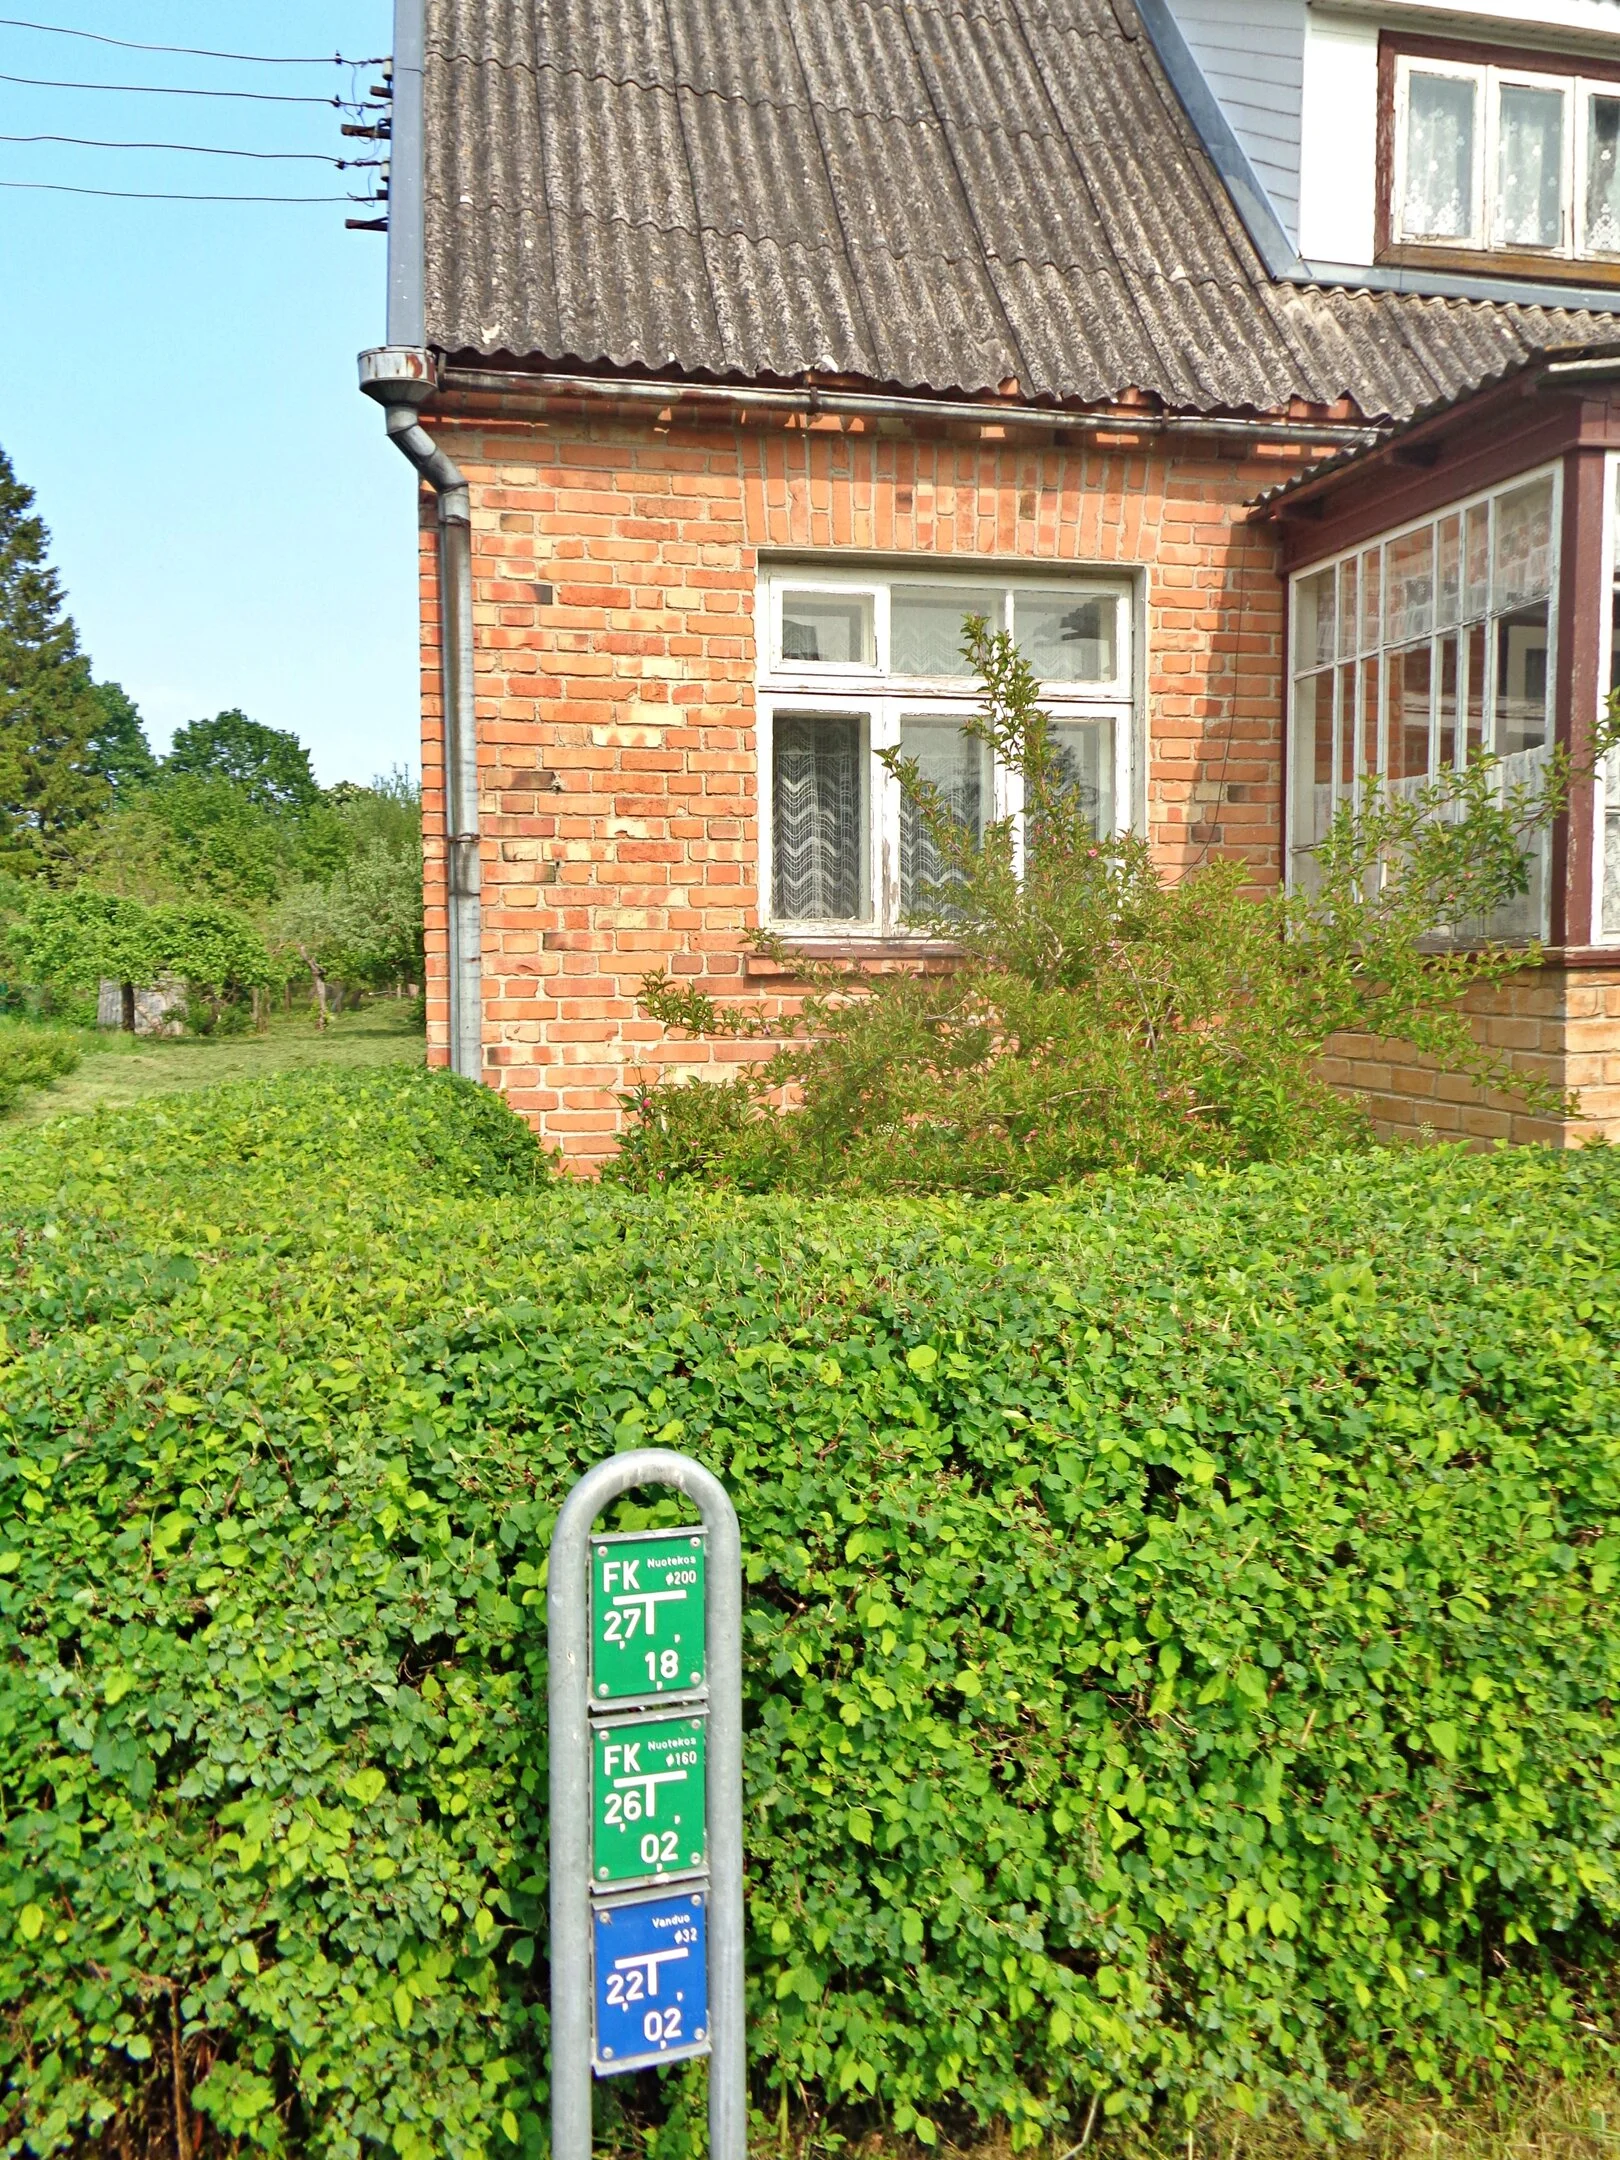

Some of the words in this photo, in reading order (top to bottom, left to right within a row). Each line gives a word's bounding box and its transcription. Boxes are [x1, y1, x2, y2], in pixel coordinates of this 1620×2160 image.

[647, 1555, 696, 1569] Nuotekos
[603, 1559, 640, 1593] FK
[647, 1737, 697, 1751] Nuotekos
[604, 1742, 641, 1776] FK
[652, 1914, 690, 1928] Vanduo
